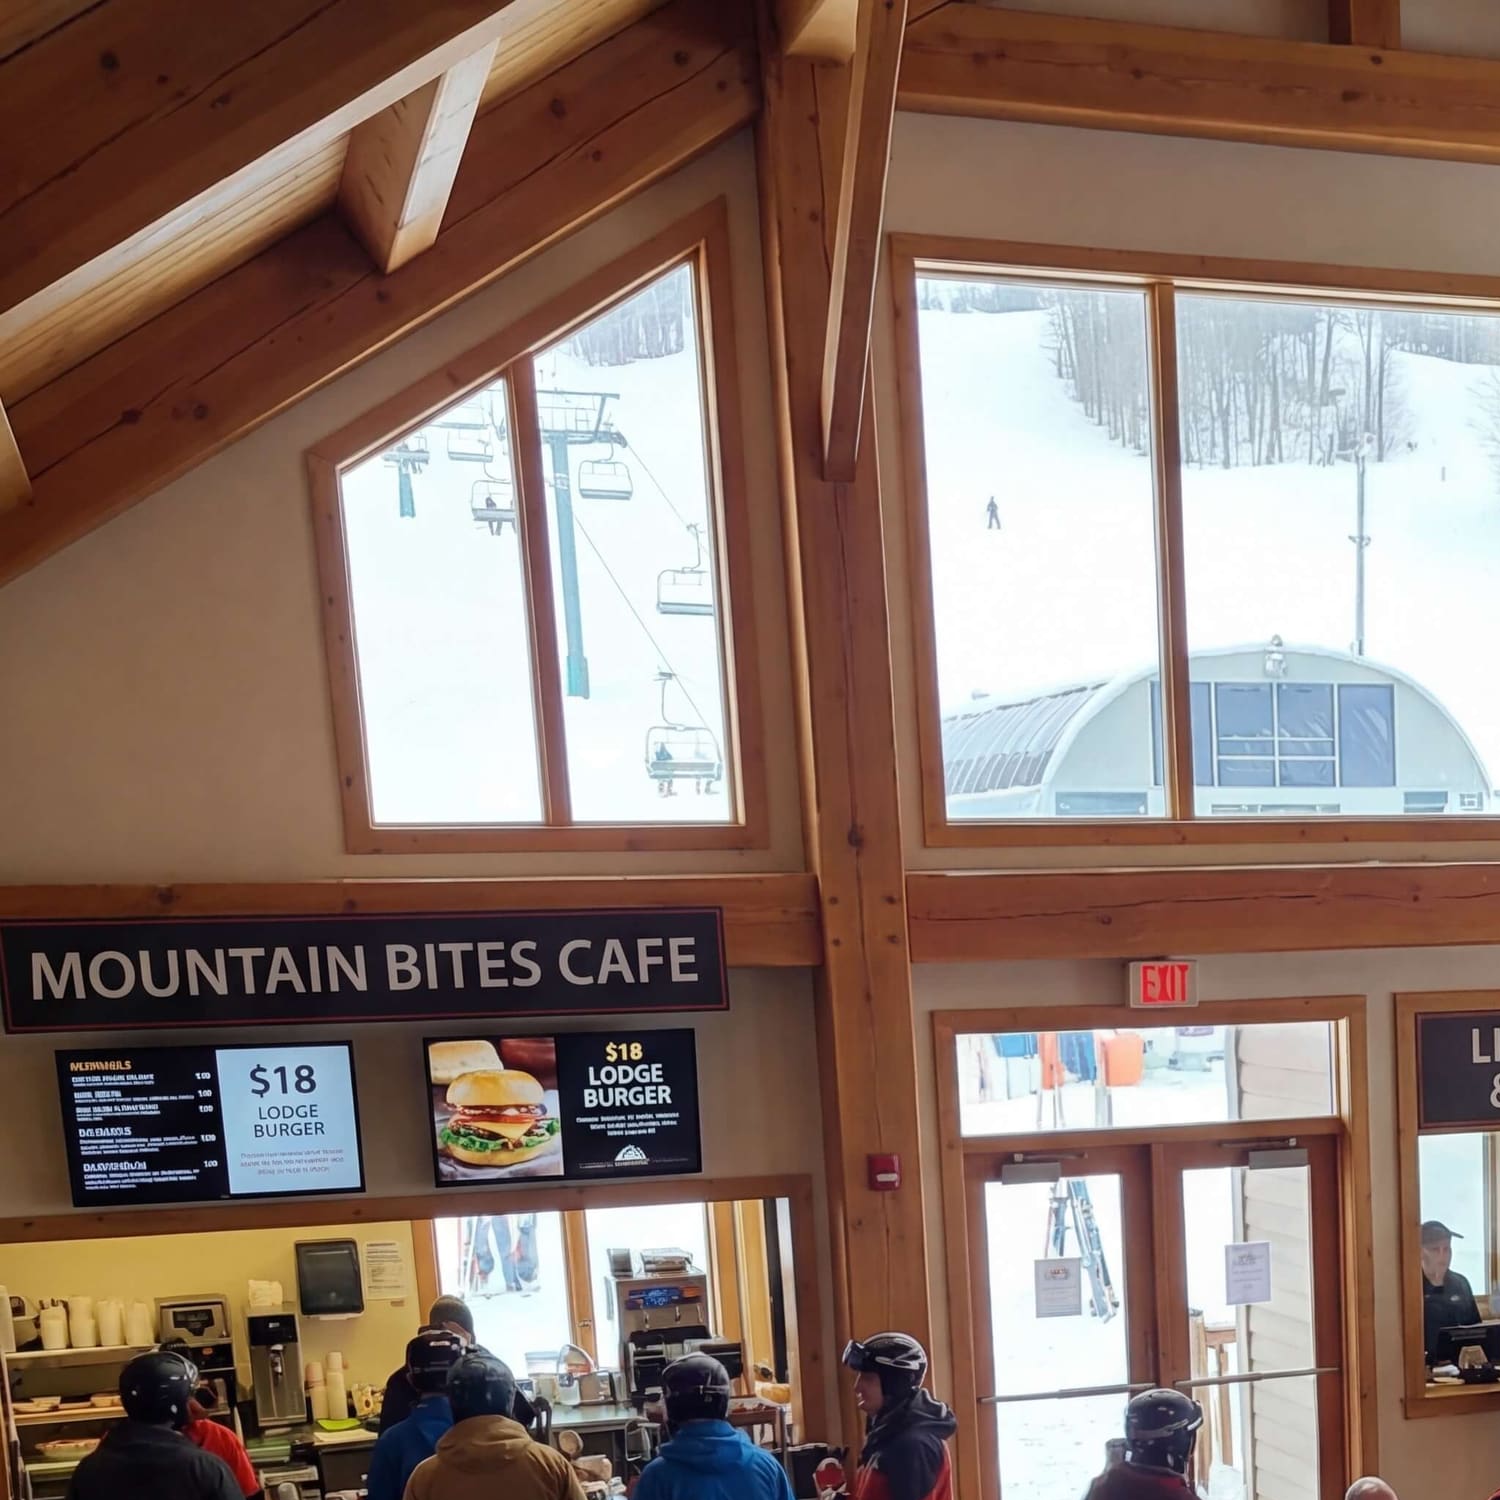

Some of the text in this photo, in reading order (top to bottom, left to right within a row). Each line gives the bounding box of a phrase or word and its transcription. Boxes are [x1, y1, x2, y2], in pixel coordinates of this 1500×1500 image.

[31, 936, 699, 1000] MOUNTAIN BITES CAFE
[1142, 964, 1189, 1003] EXIT
[605, 1041, 643, 1062] $18
[249, 1063, 317, 1098] $18
[588, 1063, 664, 1086] LODGE
[583, 1085, 673, 1108] BURGER
[258, 1104, 319, 1120] LODGE
[254, 1121, 325, 1138] BURGER
